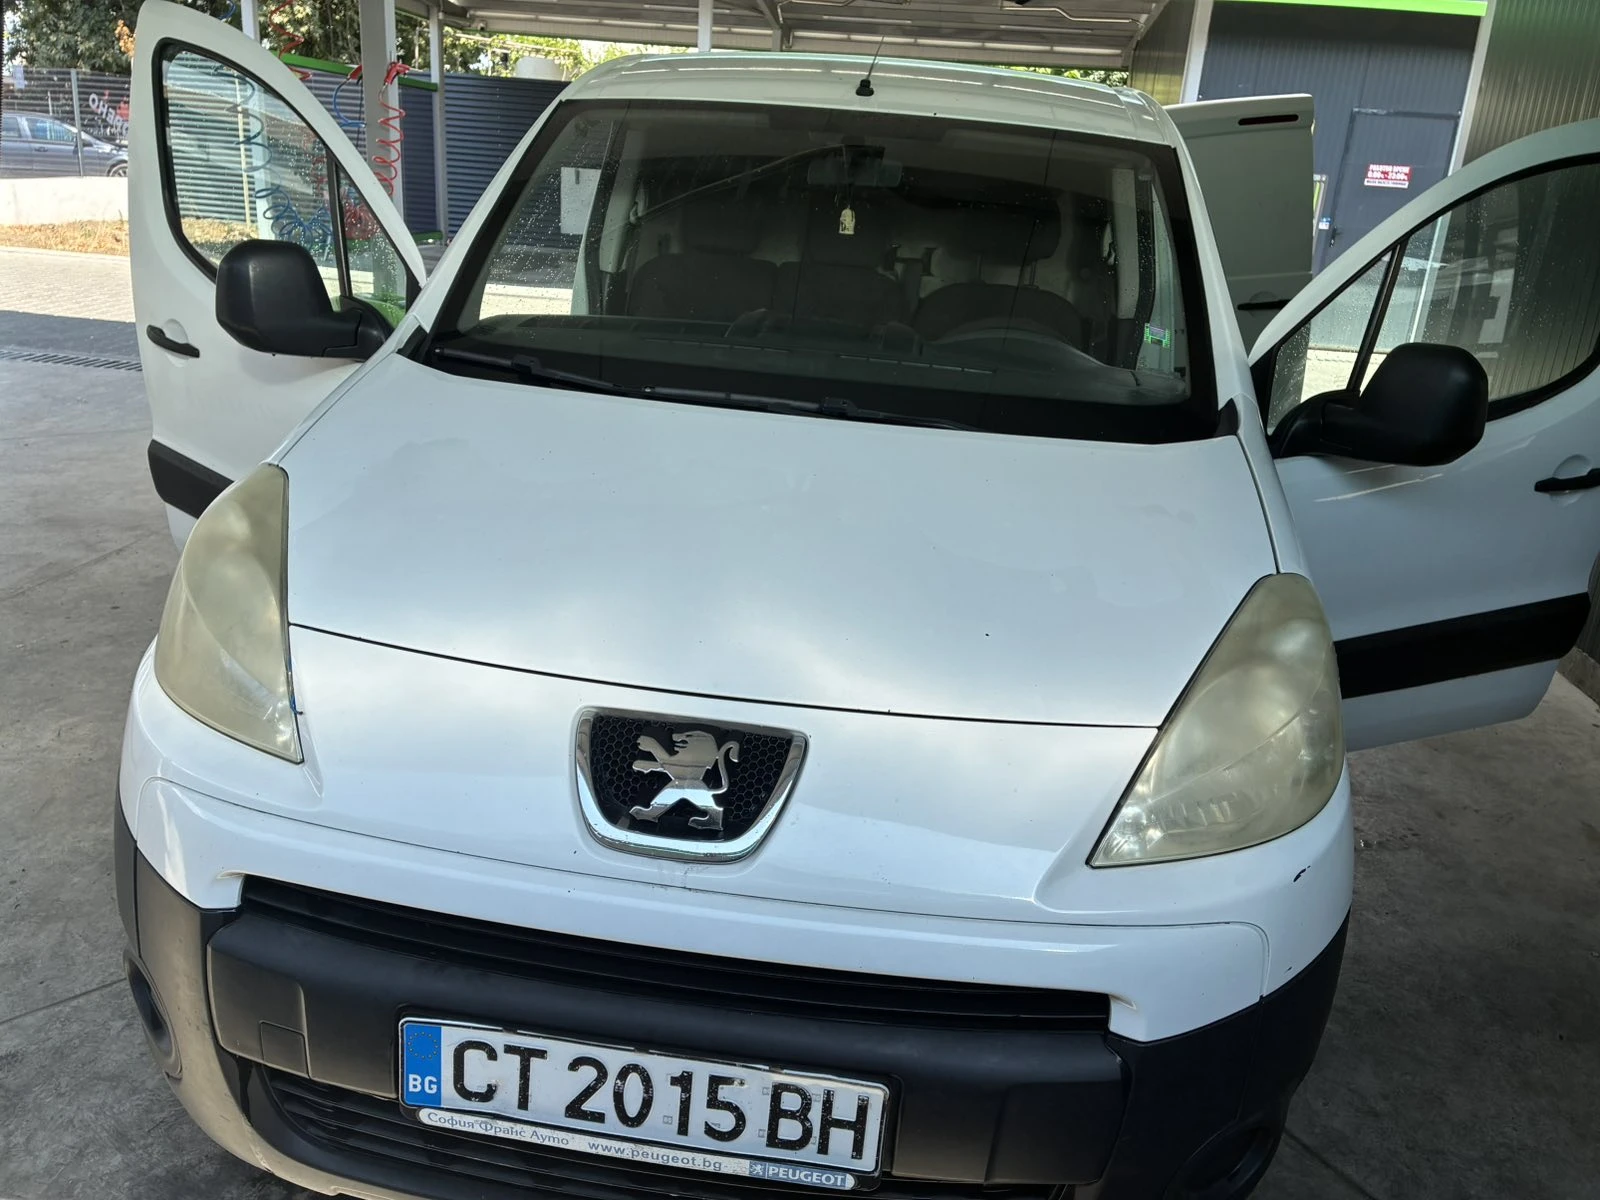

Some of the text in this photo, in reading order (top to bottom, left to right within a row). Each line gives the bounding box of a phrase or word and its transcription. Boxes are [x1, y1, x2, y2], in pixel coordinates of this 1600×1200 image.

[408, 1074, 438, 1095] BG
[453, 1039, 870, 1160] CT 2015 BH
[427, 1112, 475, 1131] София
[588, 1141, 722, 1171] www.peugeot.bg
[768, 1166, 845, 1187] PEUGEOT
